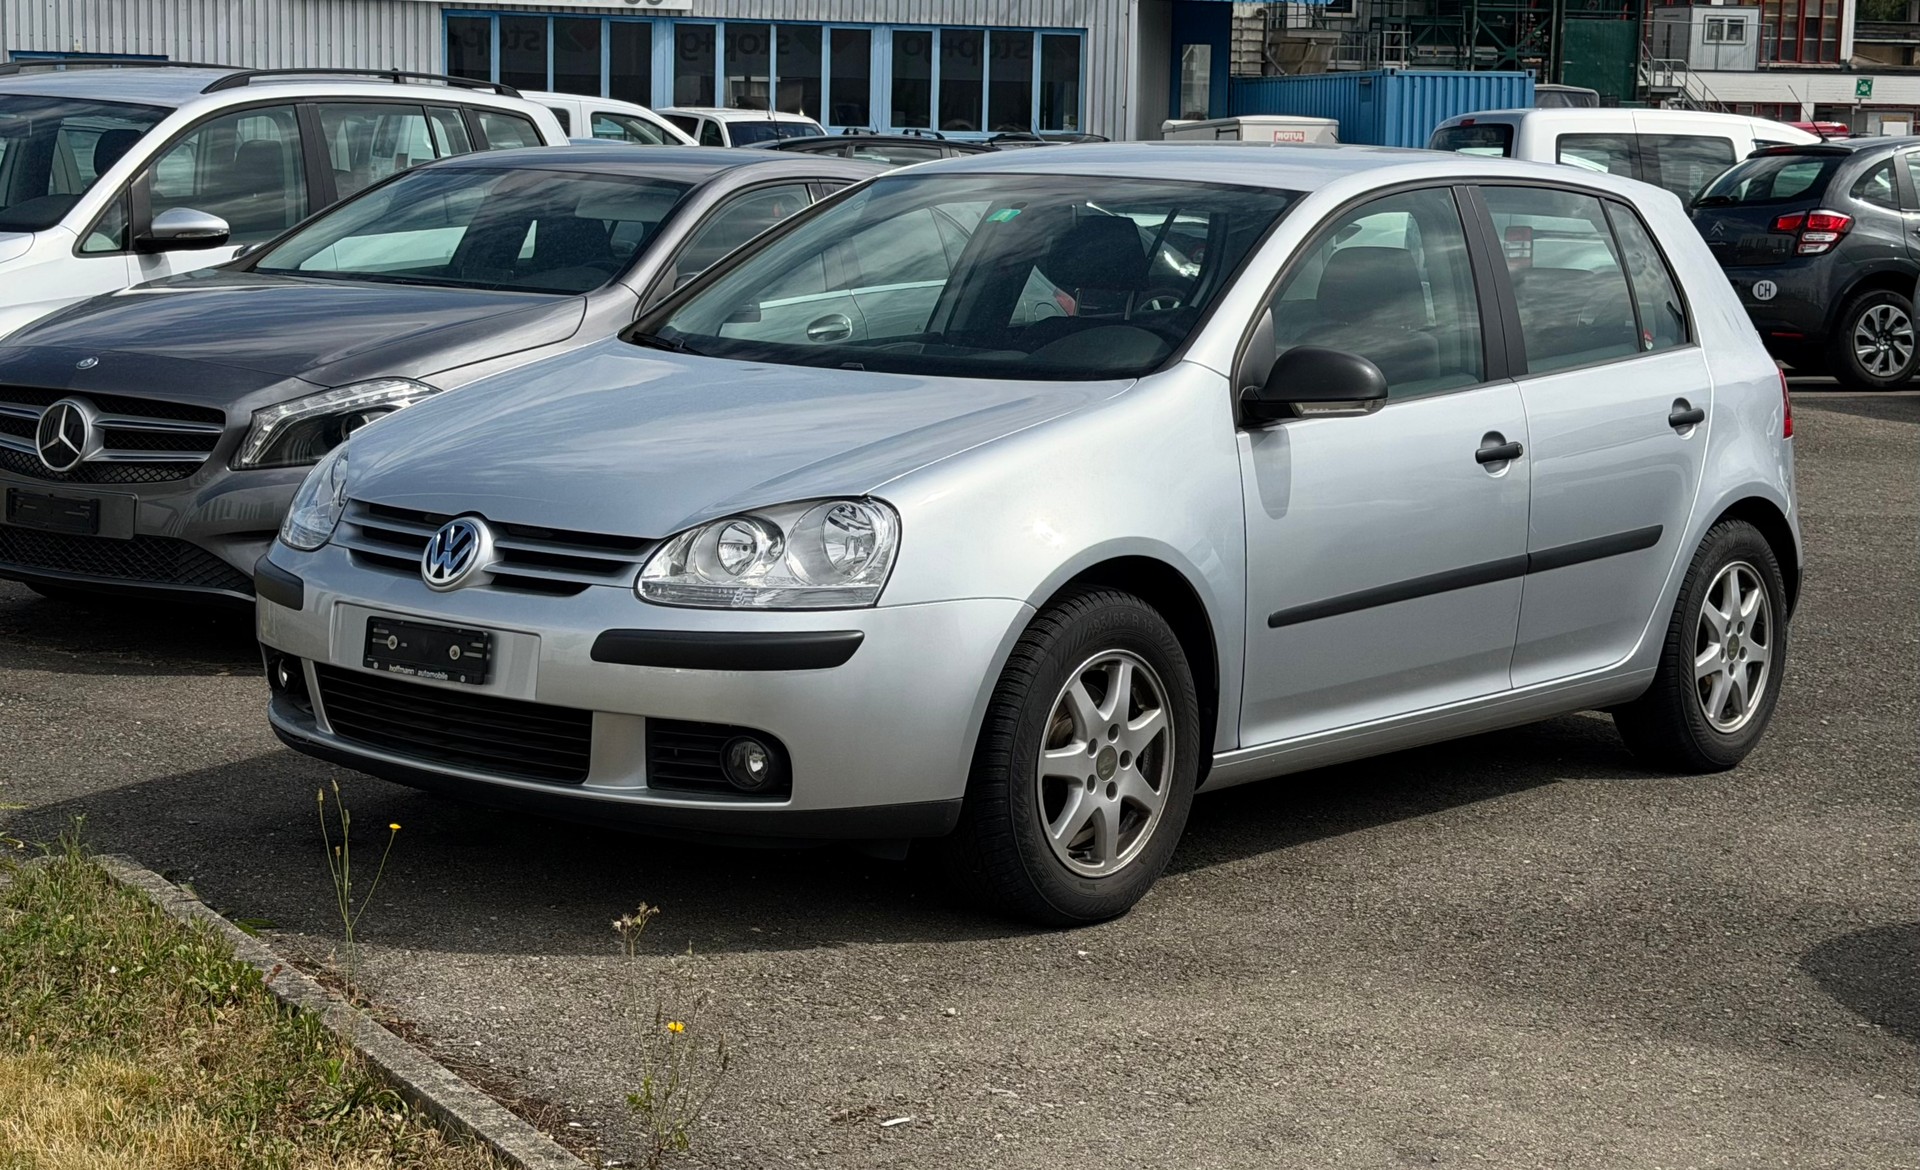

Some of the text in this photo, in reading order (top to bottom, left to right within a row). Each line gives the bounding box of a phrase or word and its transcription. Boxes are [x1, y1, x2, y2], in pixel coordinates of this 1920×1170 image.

[1757, 282, 1772, 298] CH
[389, 664, 449, 680] hoffmann automobile
